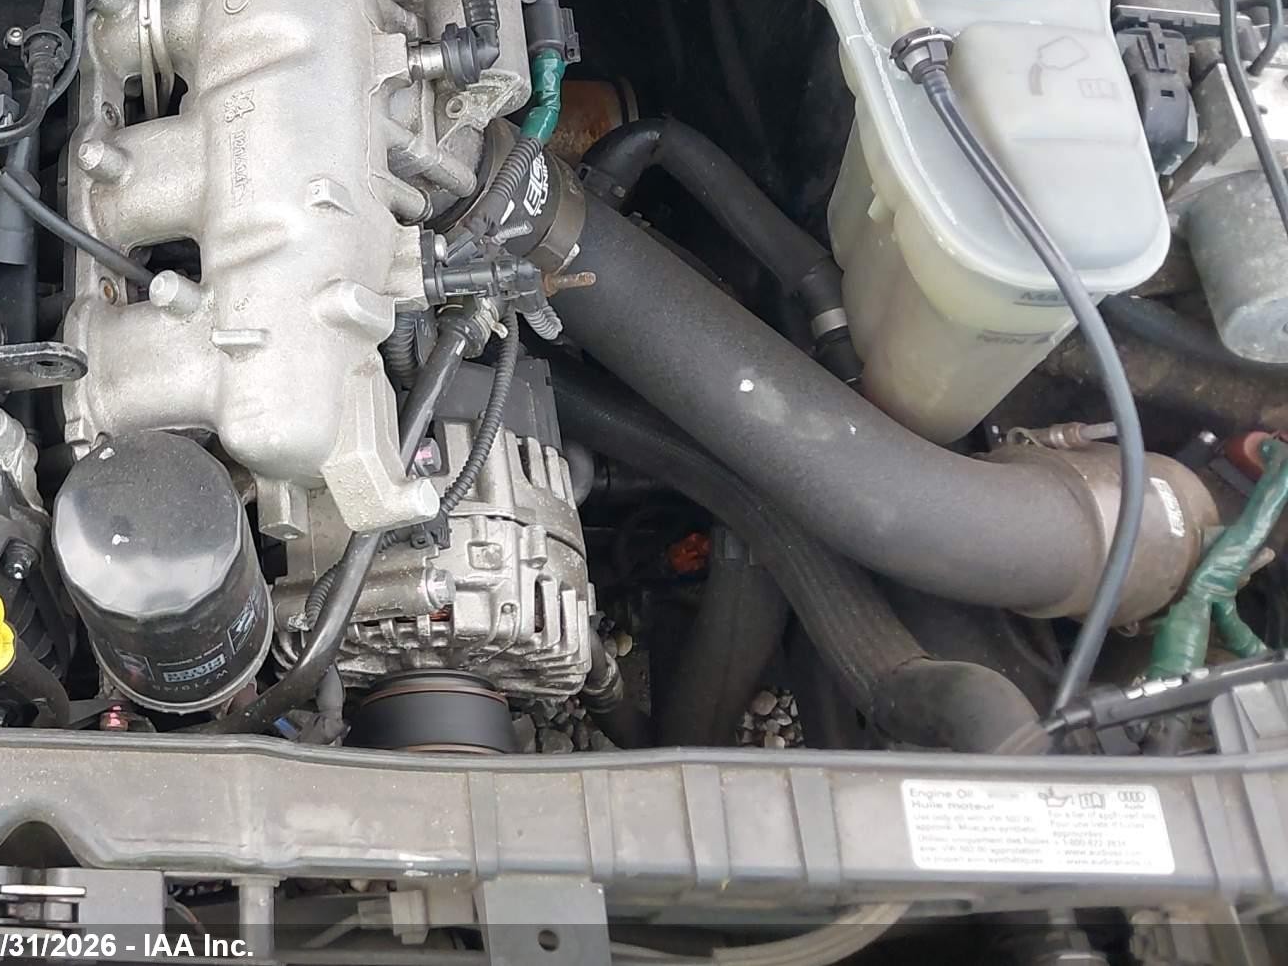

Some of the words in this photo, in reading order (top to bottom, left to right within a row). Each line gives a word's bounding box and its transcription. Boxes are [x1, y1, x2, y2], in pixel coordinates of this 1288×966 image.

[909, 787, 953, 801] Engine
[957, 788, 974, 800] Oil
[912, 800, 943, 809] Huile
[948, 801, 994, 810] moteur
